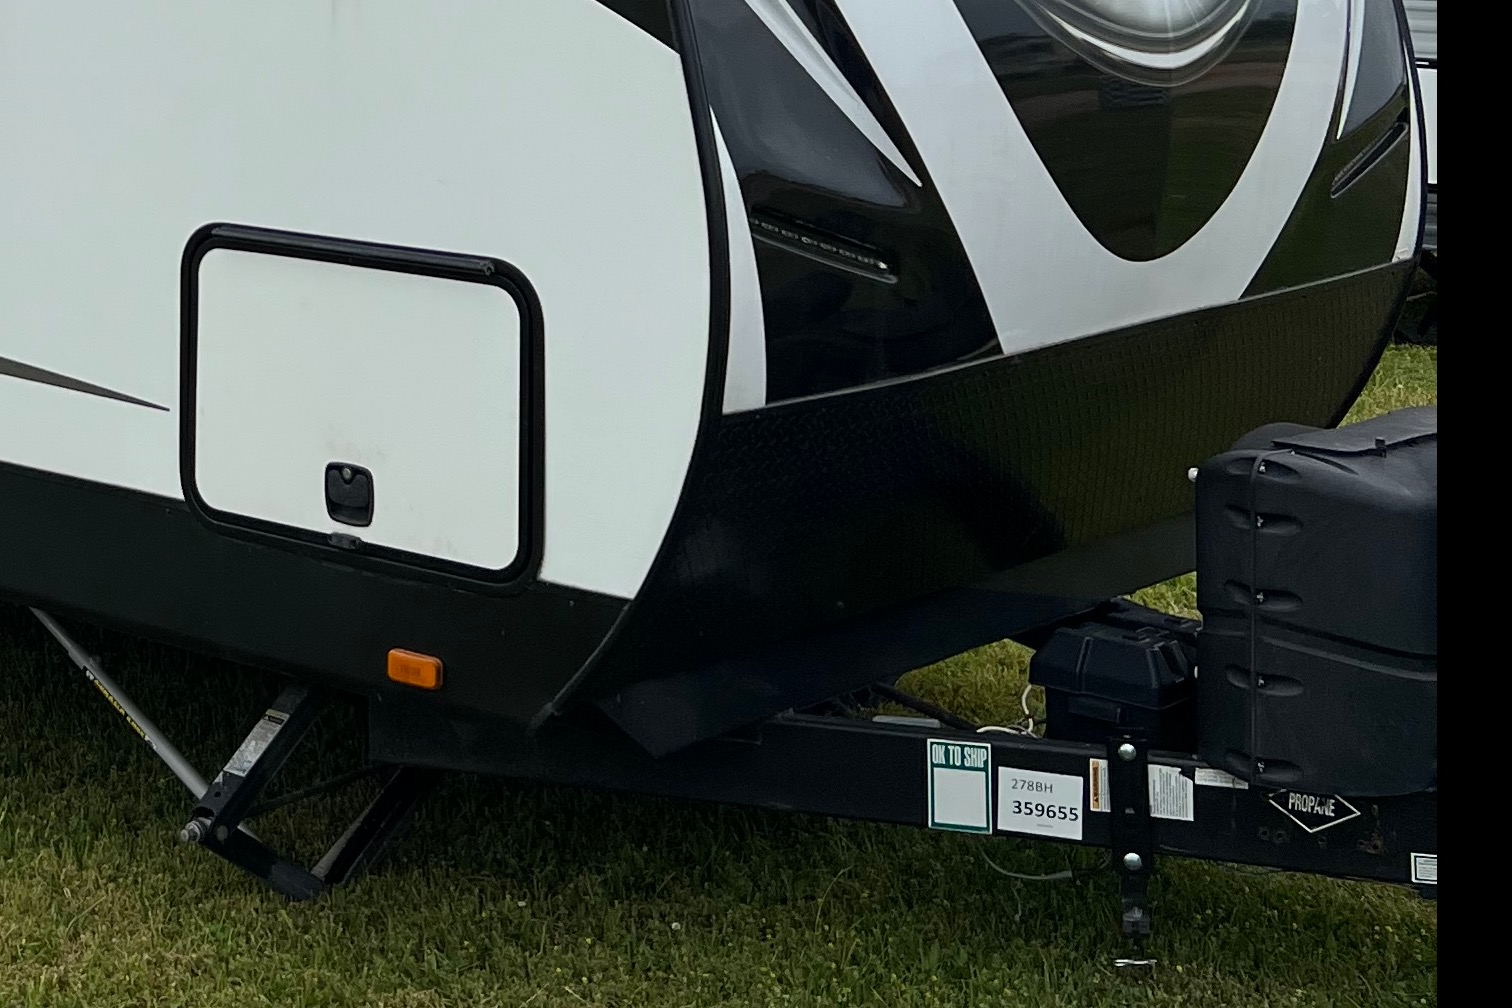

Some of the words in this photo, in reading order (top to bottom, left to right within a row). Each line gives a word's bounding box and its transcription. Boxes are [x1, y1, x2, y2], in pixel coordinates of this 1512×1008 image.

[931, 743, 946, 765] OK
[948, 745, 962, 767] TO
[963, 747, 988, 769] SHIP
[1011, 778, 1054, 794] 278BH
[1012, 800, 1079, 822] 359655
[1288, 792, 1336, 817] PROPANE
